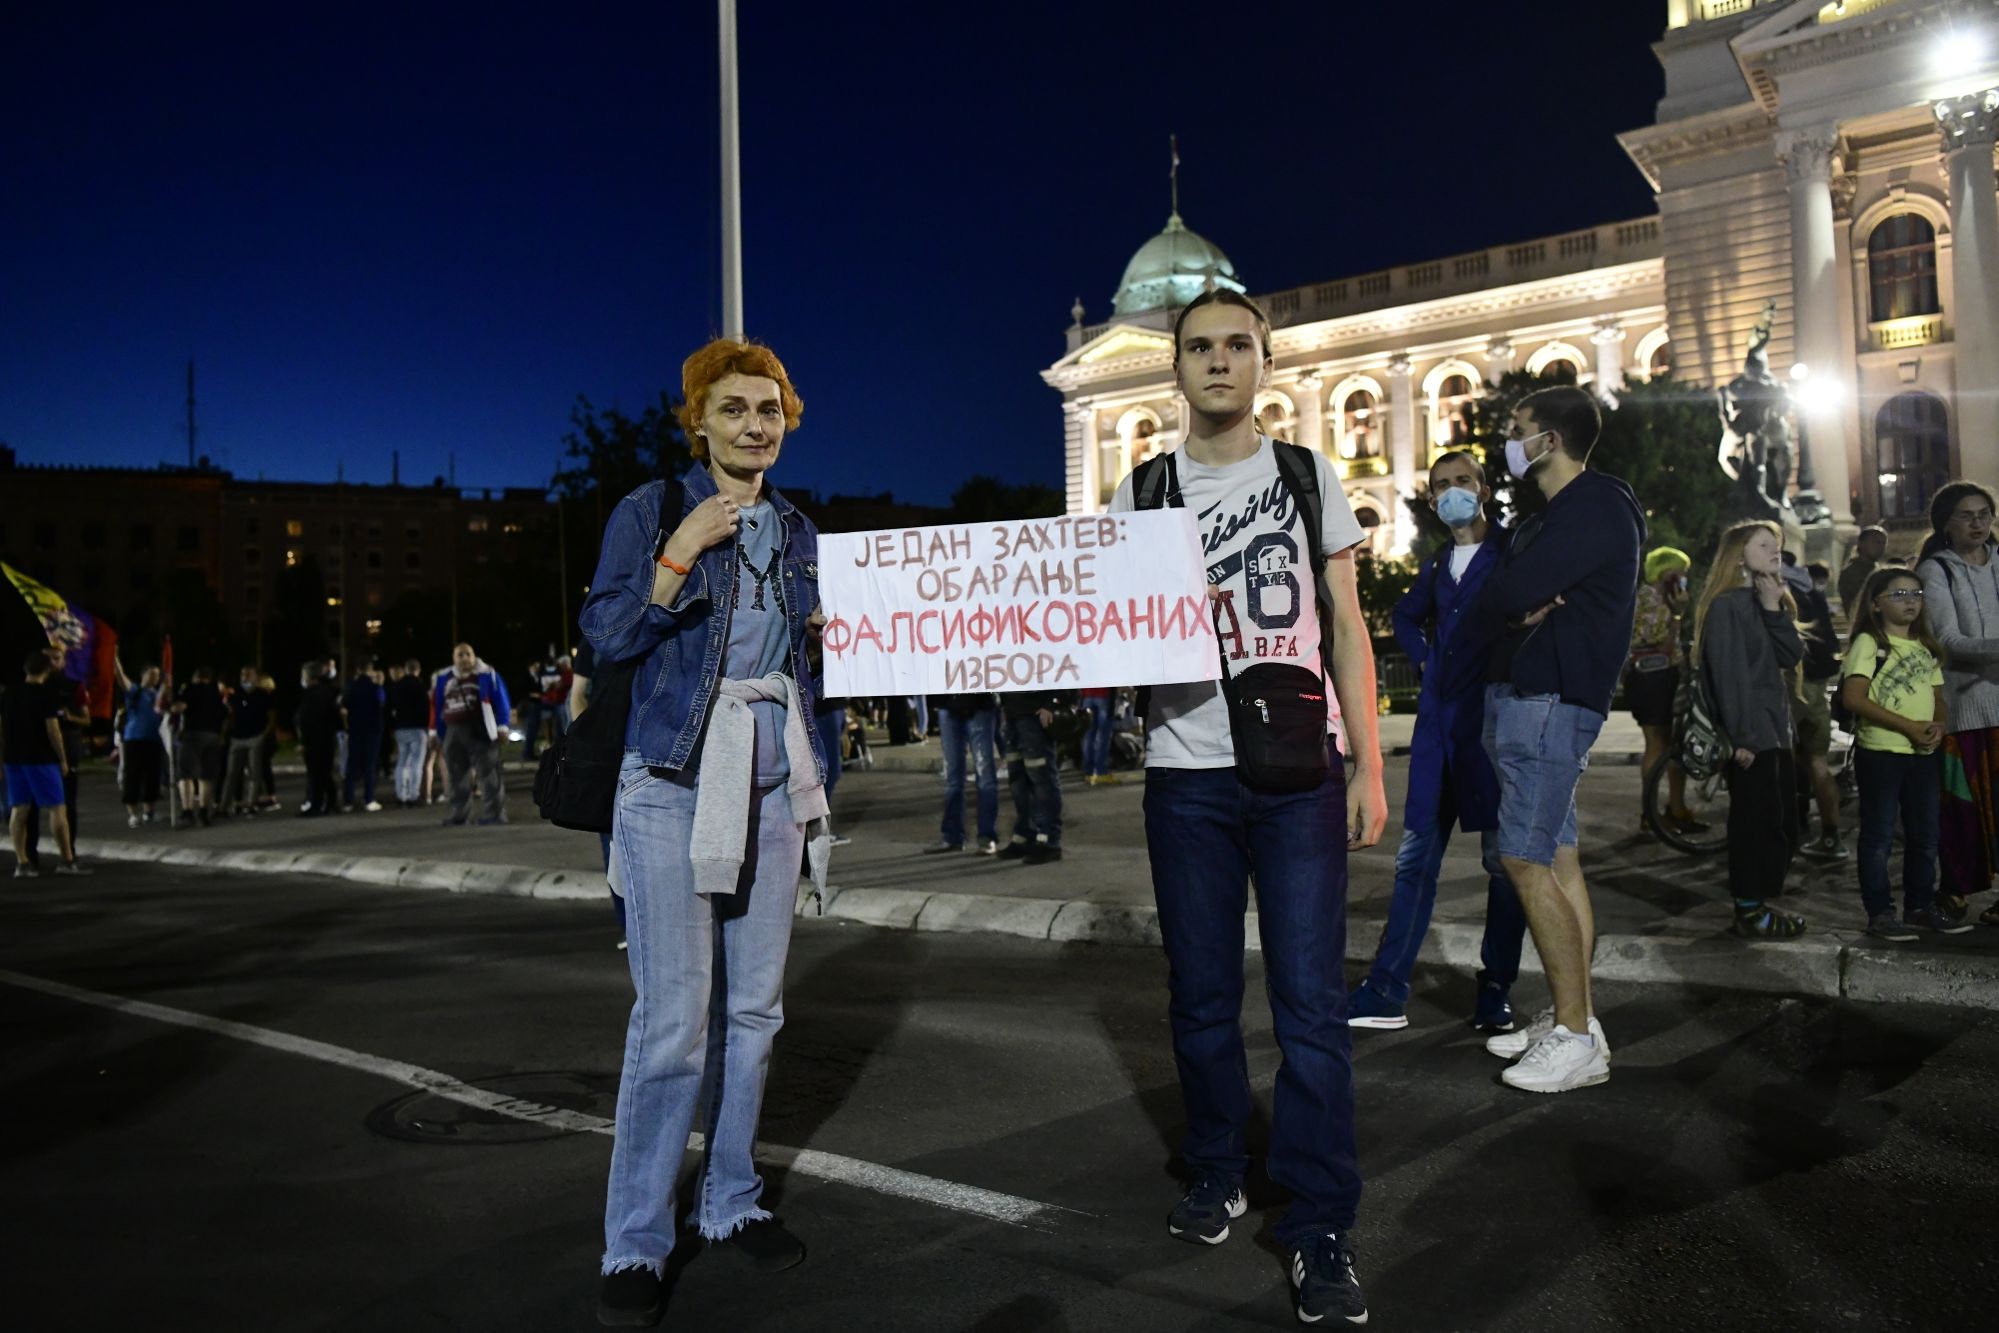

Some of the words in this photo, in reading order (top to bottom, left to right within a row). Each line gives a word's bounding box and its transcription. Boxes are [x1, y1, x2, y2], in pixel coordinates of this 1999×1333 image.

[1199, 475, 1293, 557] ising
[855, 528, 971, 570] ЈЕДАН
[992, 517, 1127, 560] ЗАХТЕВ:
[917, 554, 1097, 602] ОБАРАЊЕ
[823, 594, 1212, 660] ФАЛСИФИКОВАНИХ
[945, 652, 1080, 690] ИЗБОРА
